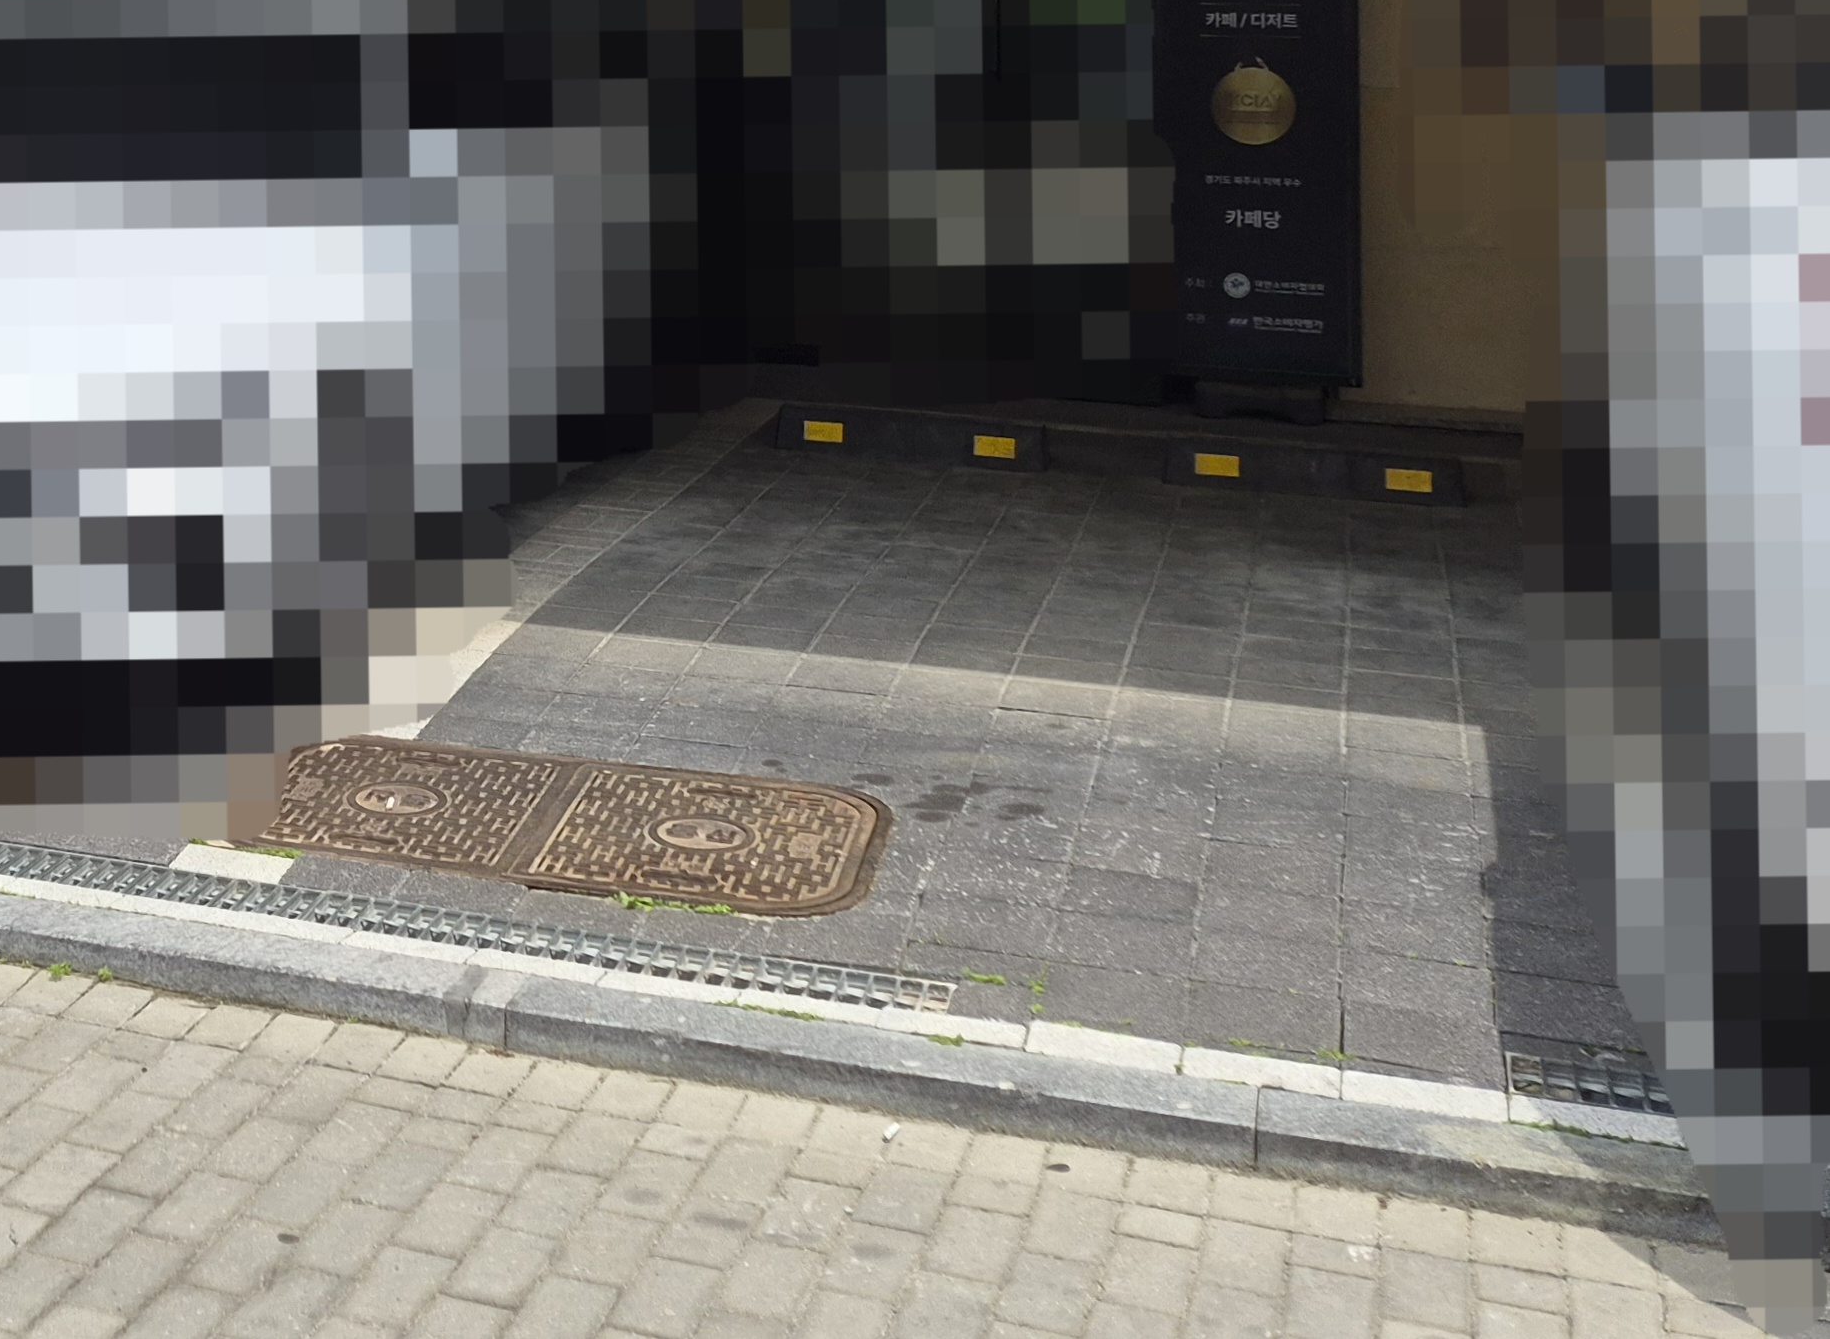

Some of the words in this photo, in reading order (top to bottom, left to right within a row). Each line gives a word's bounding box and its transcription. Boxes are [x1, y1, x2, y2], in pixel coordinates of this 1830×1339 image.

[1205, 12, 1236, 28] 카페
[1250, 12, 1298, 29] 디저트
[1225, 210, 1281, 229] 카페당
